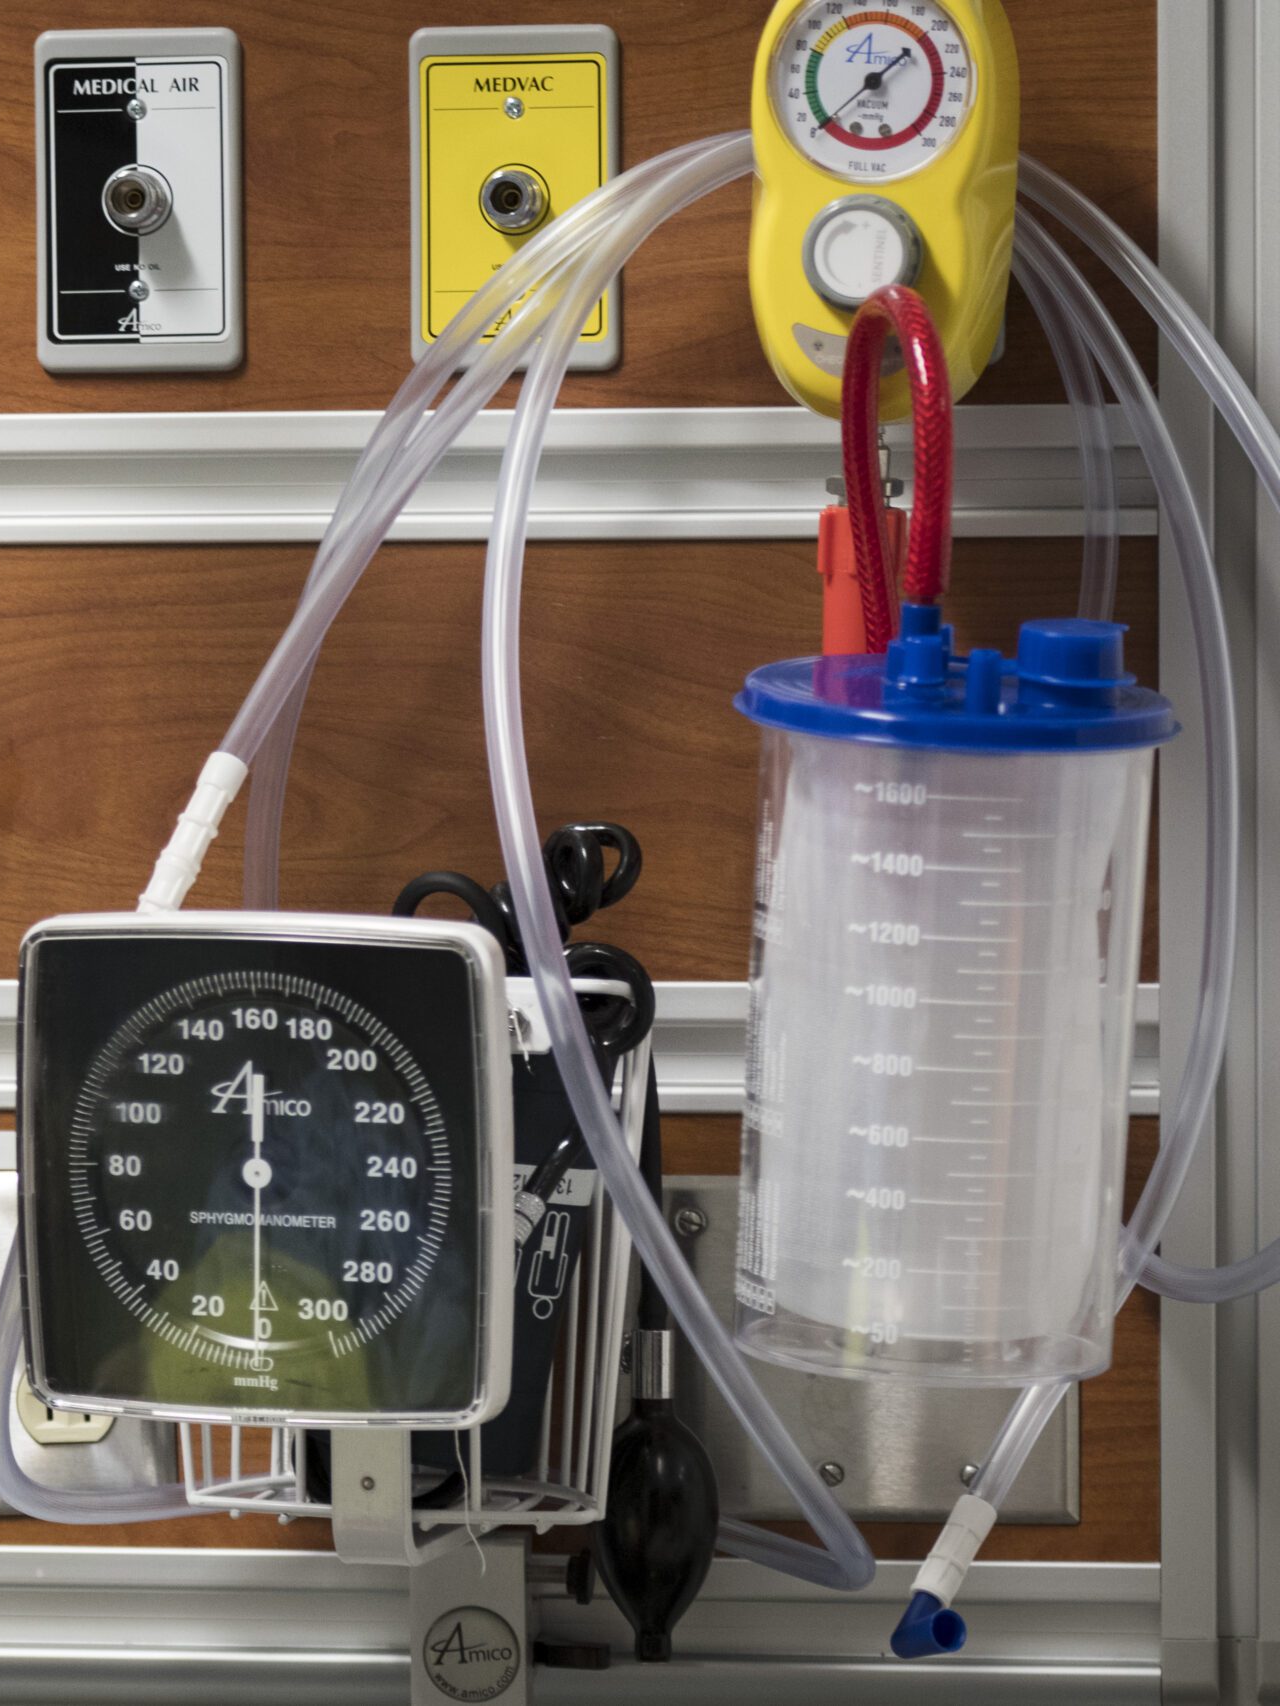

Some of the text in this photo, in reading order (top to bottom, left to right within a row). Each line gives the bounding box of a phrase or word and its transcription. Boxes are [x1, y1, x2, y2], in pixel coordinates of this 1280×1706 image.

[826, 3, 843, 15] 120
[911, 6, 926, 17] 180
[808, 19, 822, 31] 100
[931, 19, 950, 32] 200
[795, 39, 808, 51] 80
[945, 43, 960, 54] 220
[790, 63, 801, 74] 60
[949, 66, 967, 78] 240
[72, 76, 201, 96] MEDICAL AIR
[473, 75, 555, 93] MEDVAC
[788, 87, 800, 99] 40
[856, 99, 889, 110] VACUUM
[947, 92, 963, 103] 260
[796, 112, 807, 122] 20
[938, 115, 957, 128] 280
[921, 137, 937, 148] 300
[848, 160, 887, 173] FULL VAC
[113, 263, 161, 272] USE NO OIL
[871, 228, 888, 284] SENTINEL
[117, 306, 162, 332] Amico
[177, 1018, 225, 1042] 140
[231, 1007, 278, 1031] 160
[285, 1017, 333, 1041] 180
[138, 1053, 185, 1076] 120
[326, 1048, 378, 1072] 200
[210, 1059, 313, 1117] Amico
[115, 1102, 162, 1125] 100
[354, 1101, 405, 1125] 220
[108, 1154, 142, 1177] 80
[366, 1155, 418, 1179] 240
[119, 1209, 153, 1232] 60
[359, 1209, 411, 1233] 260
[145, 1258, 180, 1282] 40
[342, 1260, 394, 1284] 280
[191, 1294, 226, 1318] 20
[297, 1298, 349, 1322] 300
[256, 1317, 273, 1340] 0
[233, 1374, 279, 1392] mmHg
[429, 1620, 513, 1667] Amico
[434, 1665, 515, 1699] www.amico.com
